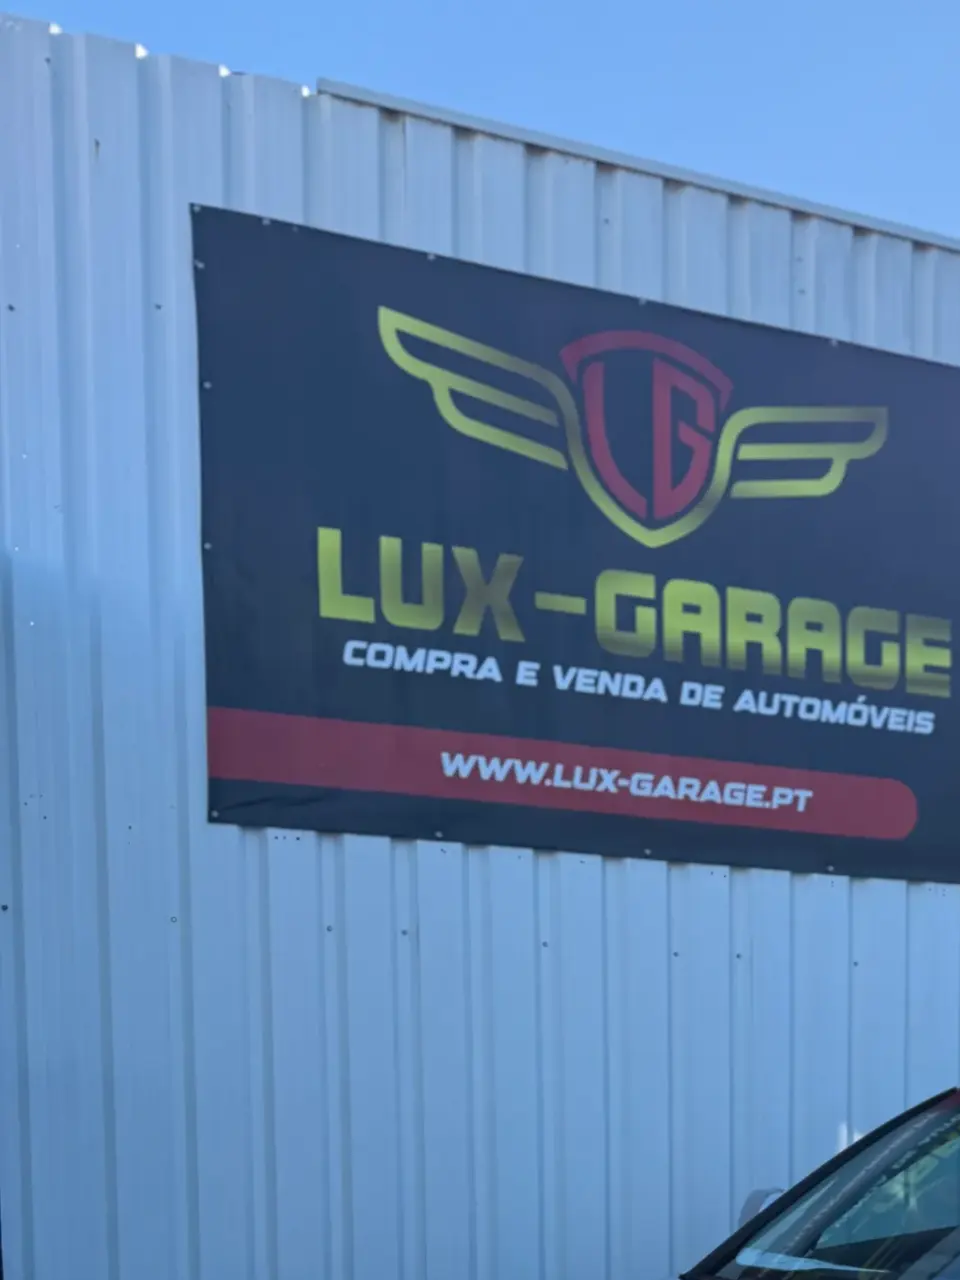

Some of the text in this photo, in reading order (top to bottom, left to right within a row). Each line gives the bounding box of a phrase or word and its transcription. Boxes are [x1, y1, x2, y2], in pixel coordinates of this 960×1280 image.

[316, 526, 953, 698] LUX-GARAGE
[342, 639, 936, 735] COMPRA E VENDA DE AUTOMÓVEIS
[440, 751, 814, 813] WWW.LUX-GARAGE.PT
